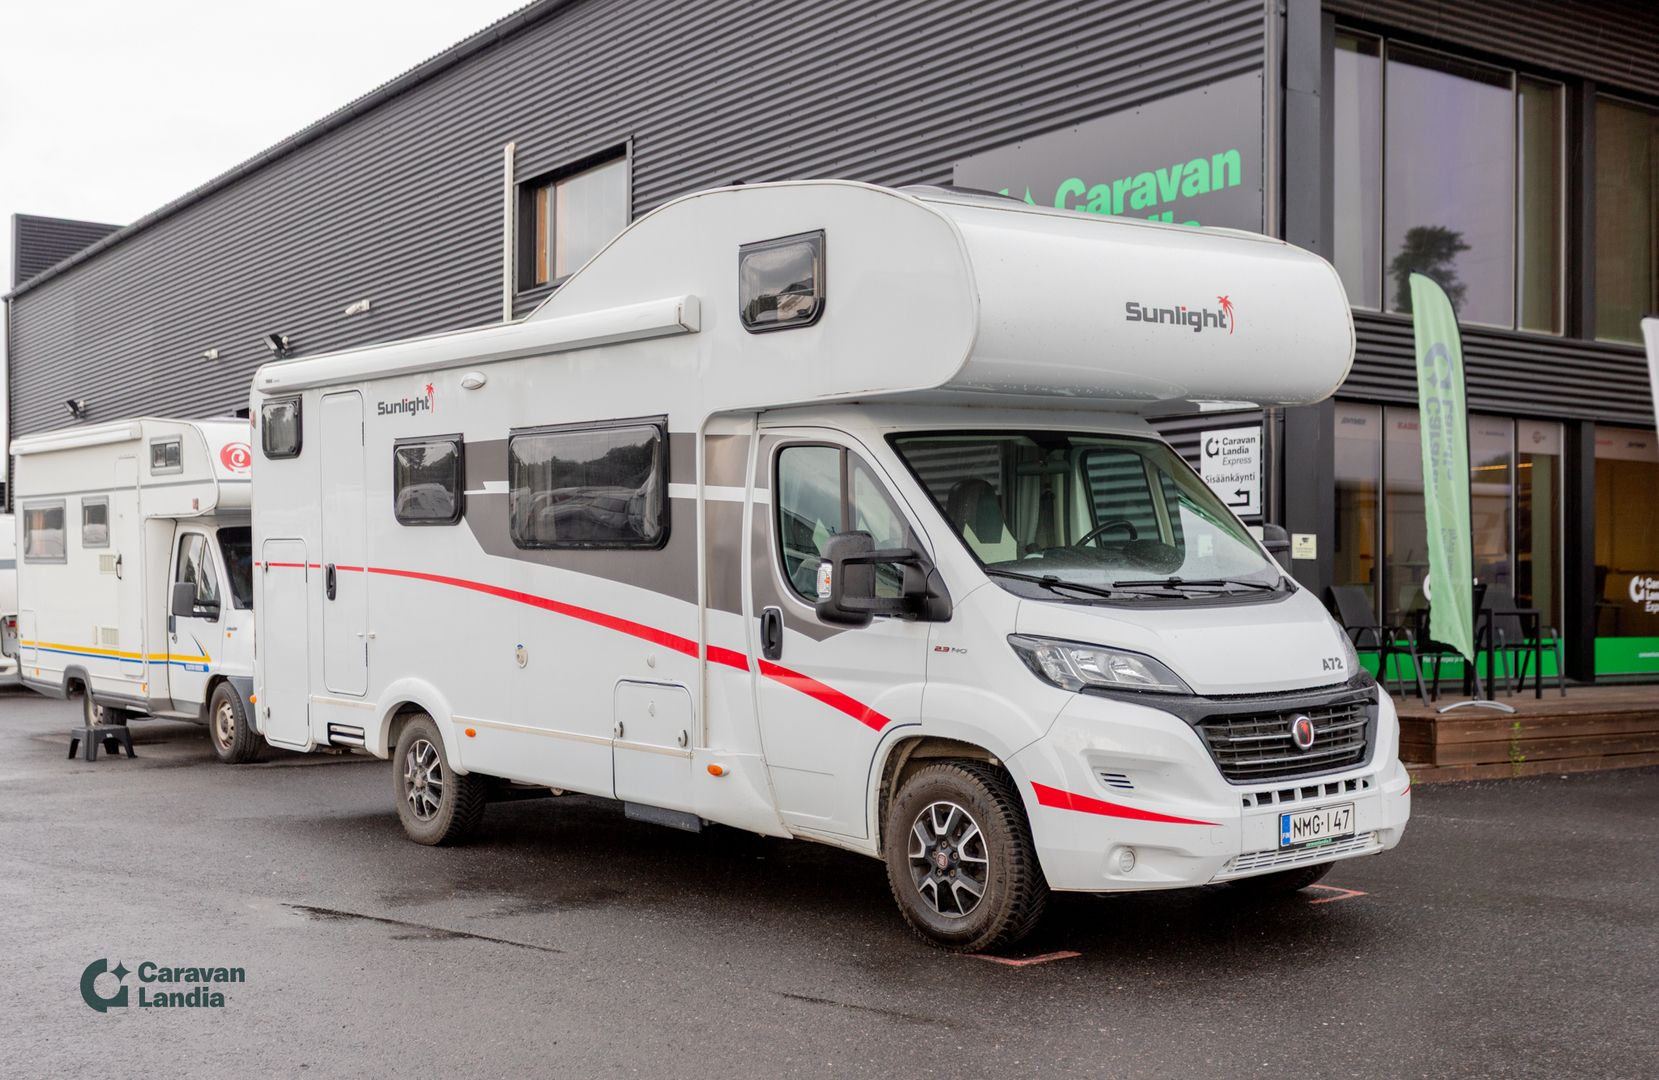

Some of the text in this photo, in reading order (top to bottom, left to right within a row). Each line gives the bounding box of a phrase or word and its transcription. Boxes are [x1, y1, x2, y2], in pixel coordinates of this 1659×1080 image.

[1054, 149, 1241, 215] Caravan
[1126, 302, 1227, 332] Sunlight
[378, 396, 430, 416] Sunlight
[1222, 437, 1255, 445] Caravan
[1222, 447, 1249, 456] Landia
[1222, 457, 1252, 466] Express
[1205, 472, 1256, 484] Sisäänkäynti
[1322, 656, 1344, 671] A72
